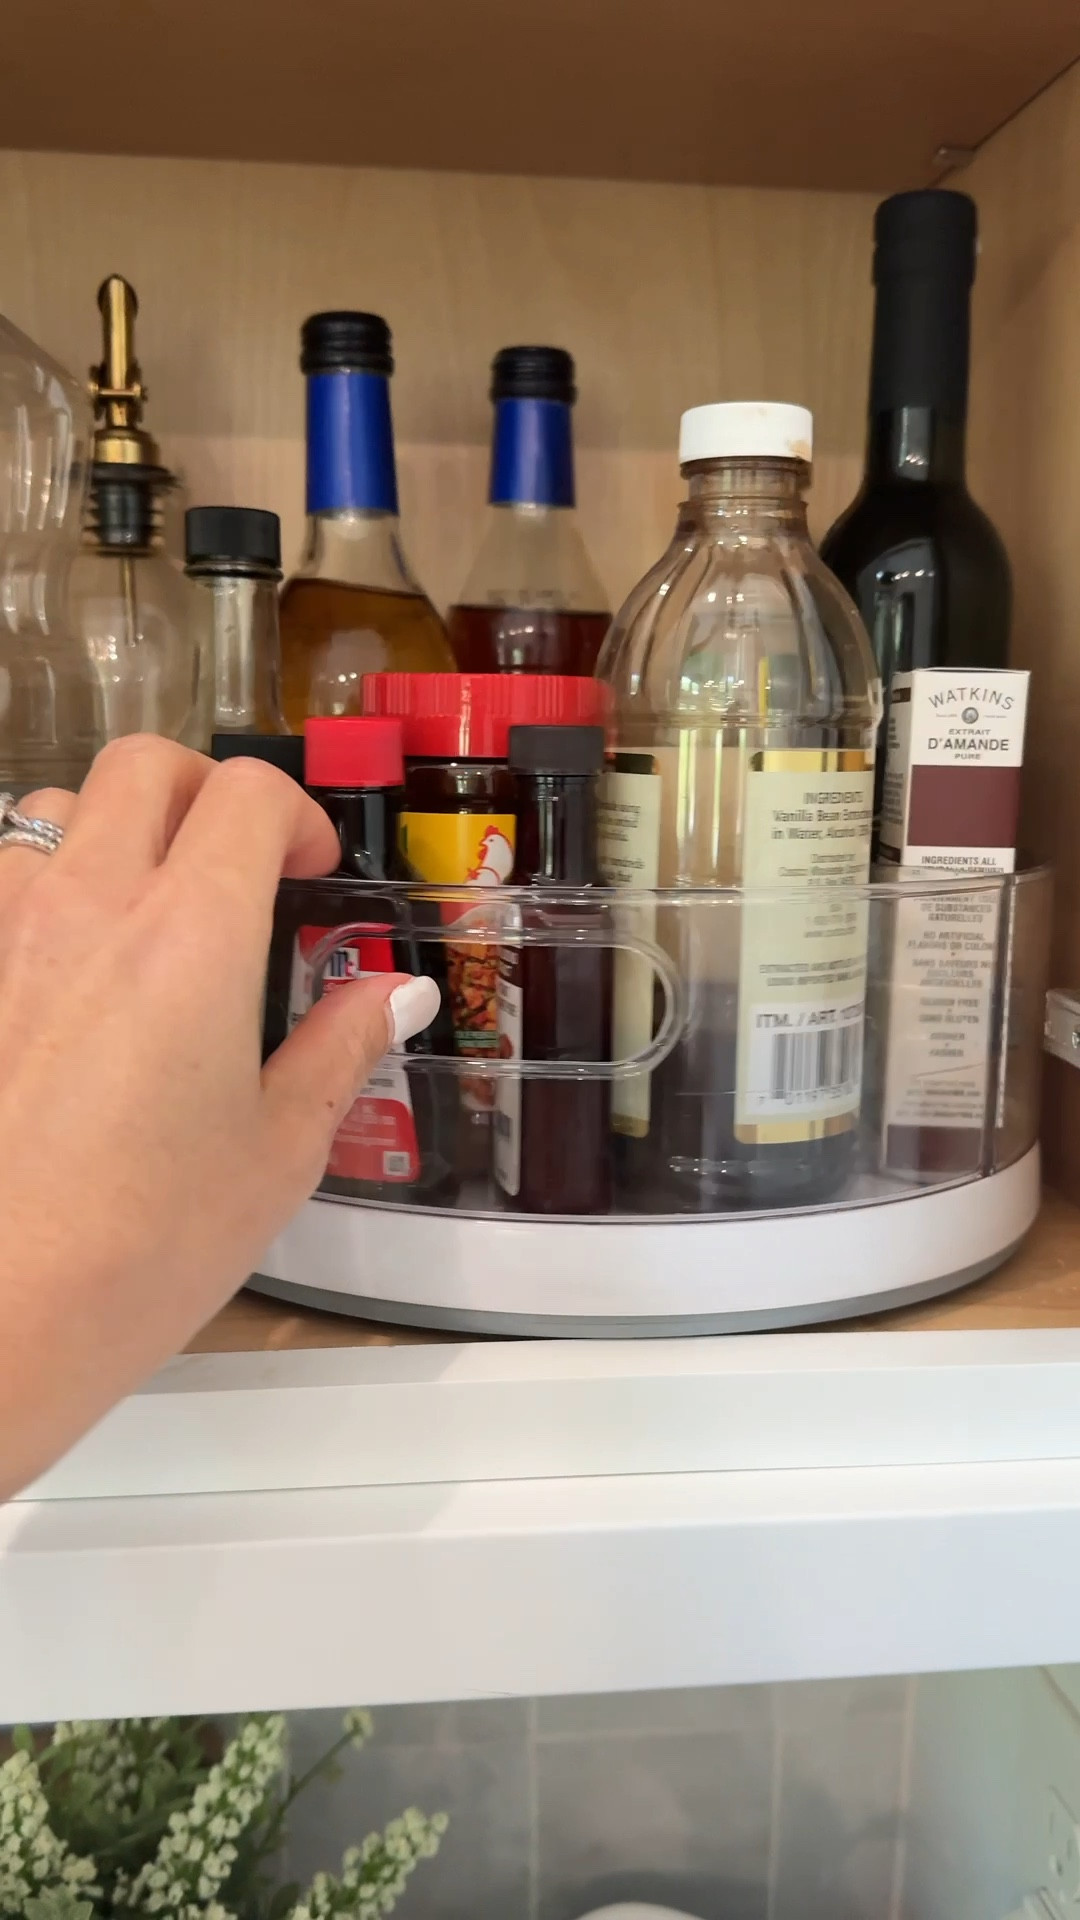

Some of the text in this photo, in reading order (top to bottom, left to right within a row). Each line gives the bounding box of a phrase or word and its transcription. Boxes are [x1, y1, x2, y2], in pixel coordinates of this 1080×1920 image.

[928, 687, 1015, 710] WATKINS
[948, 728, 991, 736] EXTRAIT
[928, 738, 1009, 751] D'AMANDE
[921, 856, 997, 866] INGREDIENTS ALL
